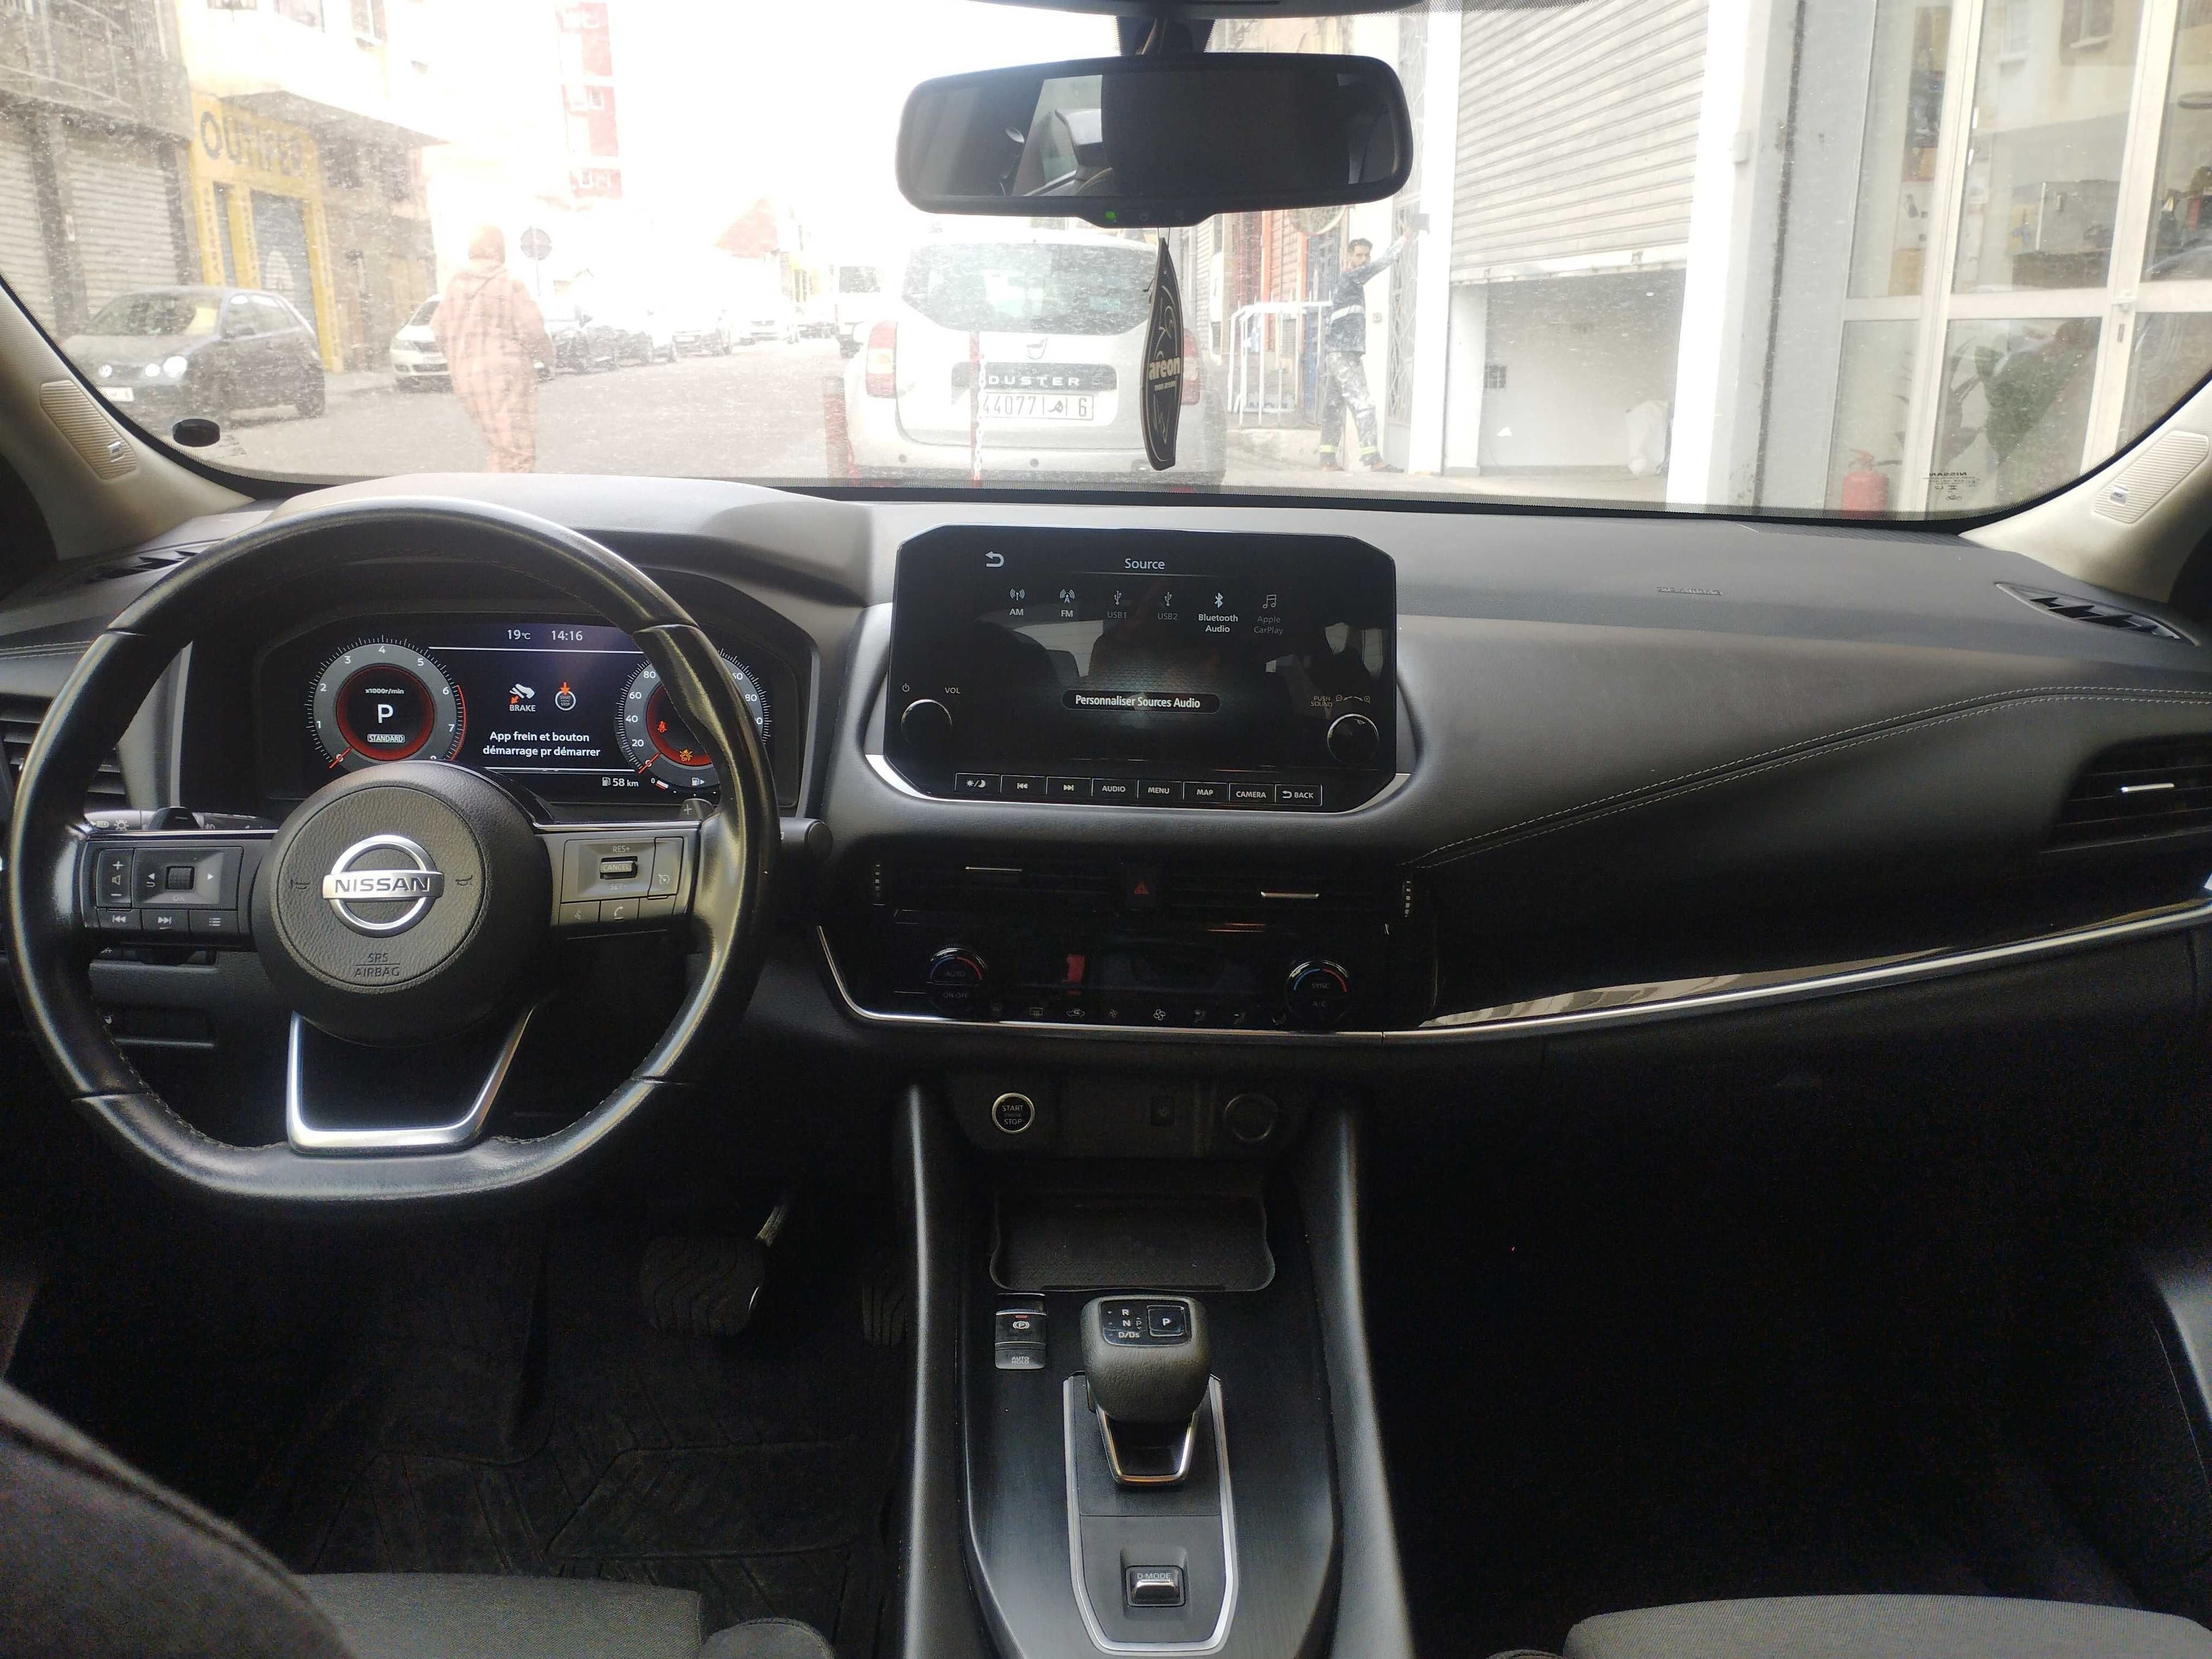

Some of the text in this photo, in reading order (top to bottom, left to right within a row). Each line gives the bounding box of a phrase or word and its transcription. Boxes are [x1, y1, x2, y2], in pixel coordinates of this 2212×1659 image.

[1149, 357, 1180, 380] areon
[988, 375, 1080, 387] DUSTER
[983, 395, 1036, 415] 44077
[1078, 397, 1087, 417] 6
[1125, 558, 1165, 570] Source
[1198, 613, 1238, 622] Bluetooth
[1257, 616, 1281, 624] Apple
[551, 630, 583, 641] 14:16
[1253, 626, 1284, 635] CarPlay
[378, 646, 385, 654] 4
[1075, 695, 1200, 708] Personnaliser Sources Audio
[378, 704, 393, 724] P
[317, 721, 321, 729] 1
[448, 724, 455, 732] 7
[490, 731, 589, 743] App frein et bouton
[483, 745, 601, 757] démarrage pr démarrer
[612, 778, 639, 787] 58 km
[335, 877, 430, 893] NISSAN
[368, 952, 389, 963] SRS
[354, 966, 400, 978] AIRBAG
